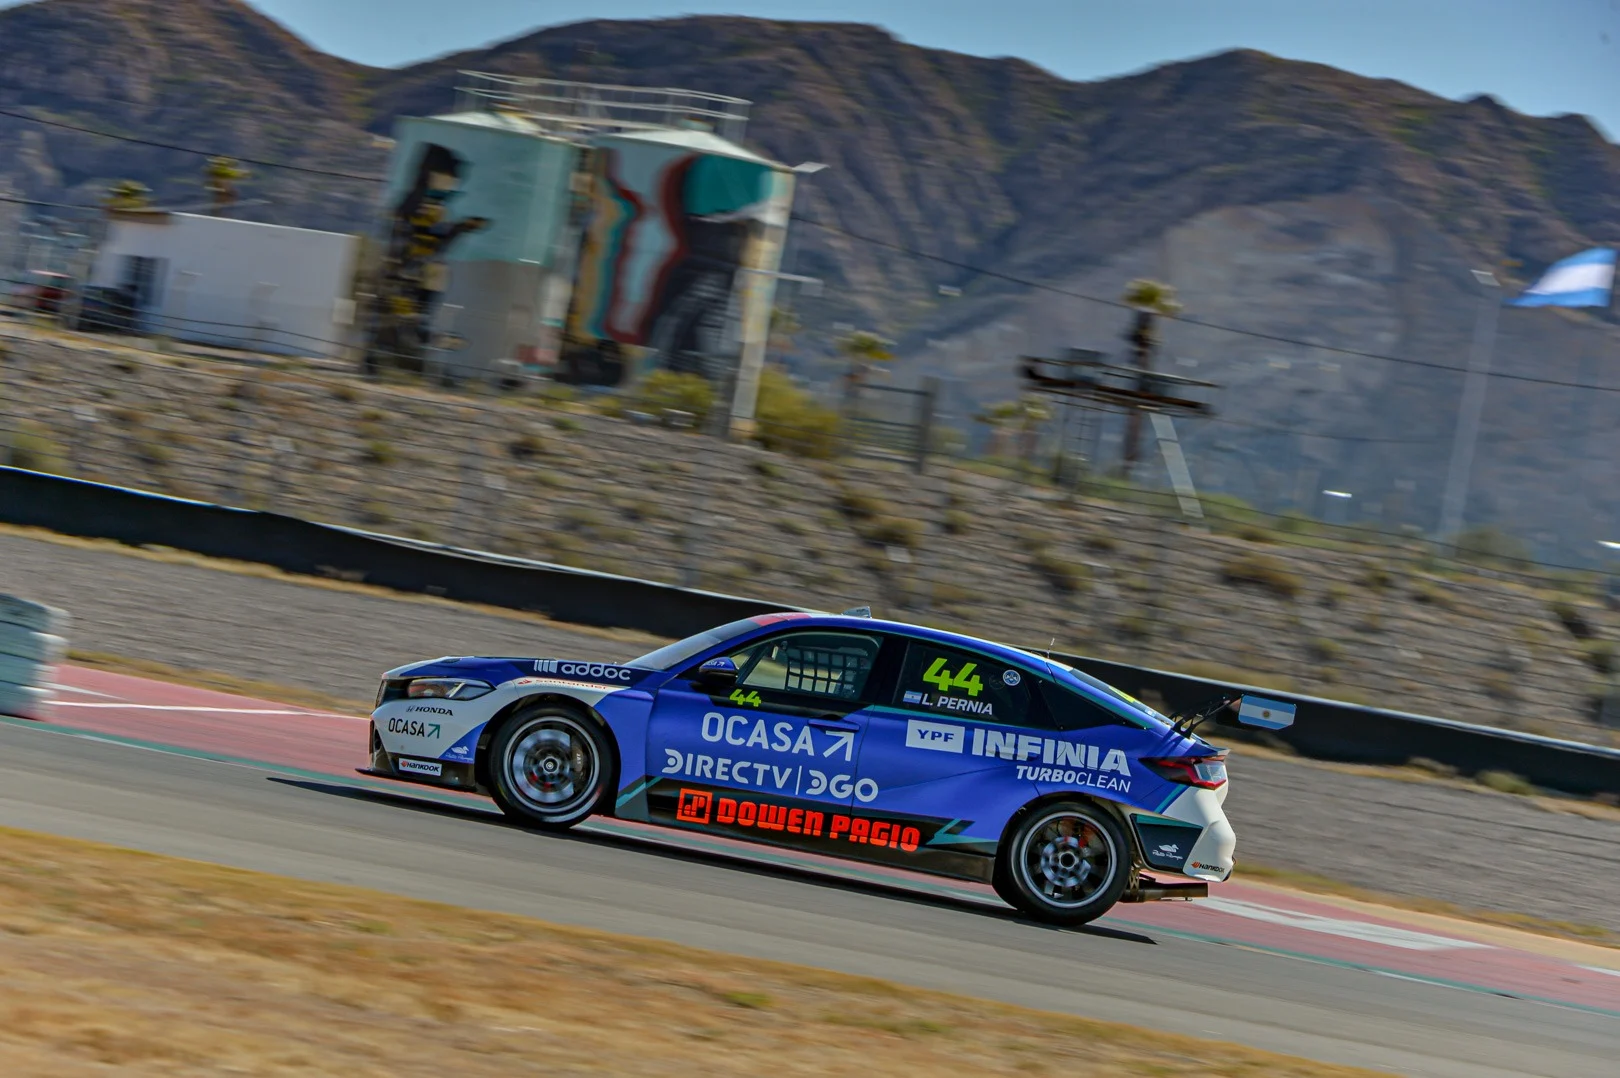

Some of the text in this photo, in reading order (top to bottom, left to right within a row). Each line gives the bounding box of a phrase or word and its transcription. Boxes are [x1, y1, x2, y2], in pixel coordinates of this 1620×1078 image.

[561, 661, 631, 680] addoc
[923, 657, 983, 697] 44
[415, 706, 453, 716] HONDA
[730, 689, 762, 707] 44
[922, 693, 993, 715] L. PERNIA
[388, 717, 425, 737] OCASA
[701, 712, 814, 756] OCASA
[917, 728, 1131, 777] YPF INFINIA
[662, 749, 879, 802] DIRECTV DGO
[1016, 765, 1131, 793] TURBOCLEAN
[716, 798, 920, 852] DOWEN PAGIO
